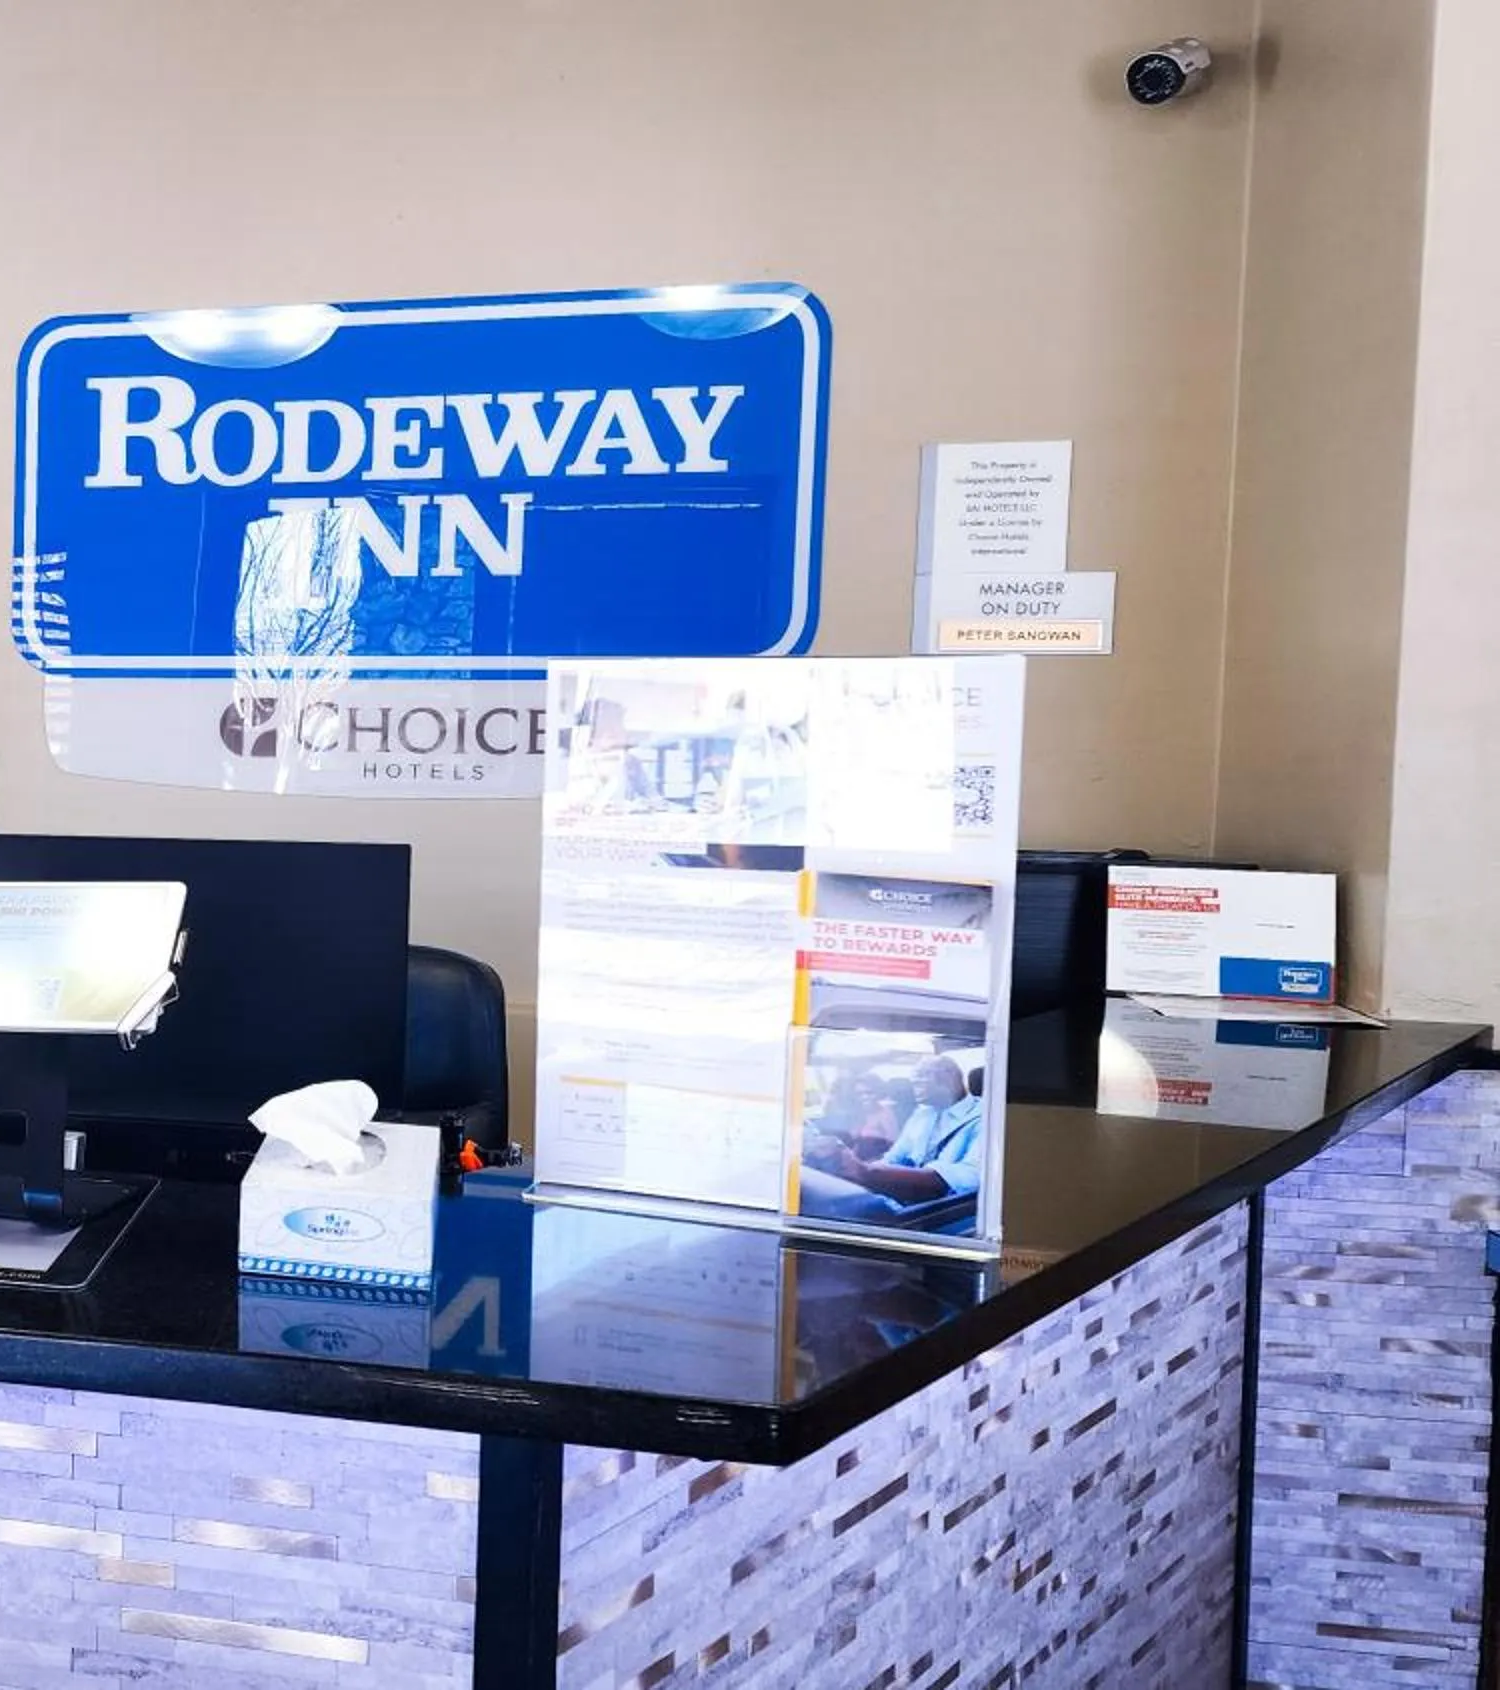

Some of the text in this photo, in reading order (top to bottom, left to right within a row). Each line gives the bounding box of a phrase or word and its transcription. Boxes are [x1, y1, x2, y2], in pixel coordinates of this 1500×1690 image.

[84, 375, 744, 488] RODEWAY
[268, 492, 534, 582] INN
[979, 581, 1066, 596] MANAGER
[981, 601, 1061, 616] ON DUTY
[957, 629, 1003, 641] PETER
[362, 763, 486, 782] HOTELS
[813, 921, 976, 944] THE FASTER WAY
[813, 936, 938, 957] TO REWARDS
